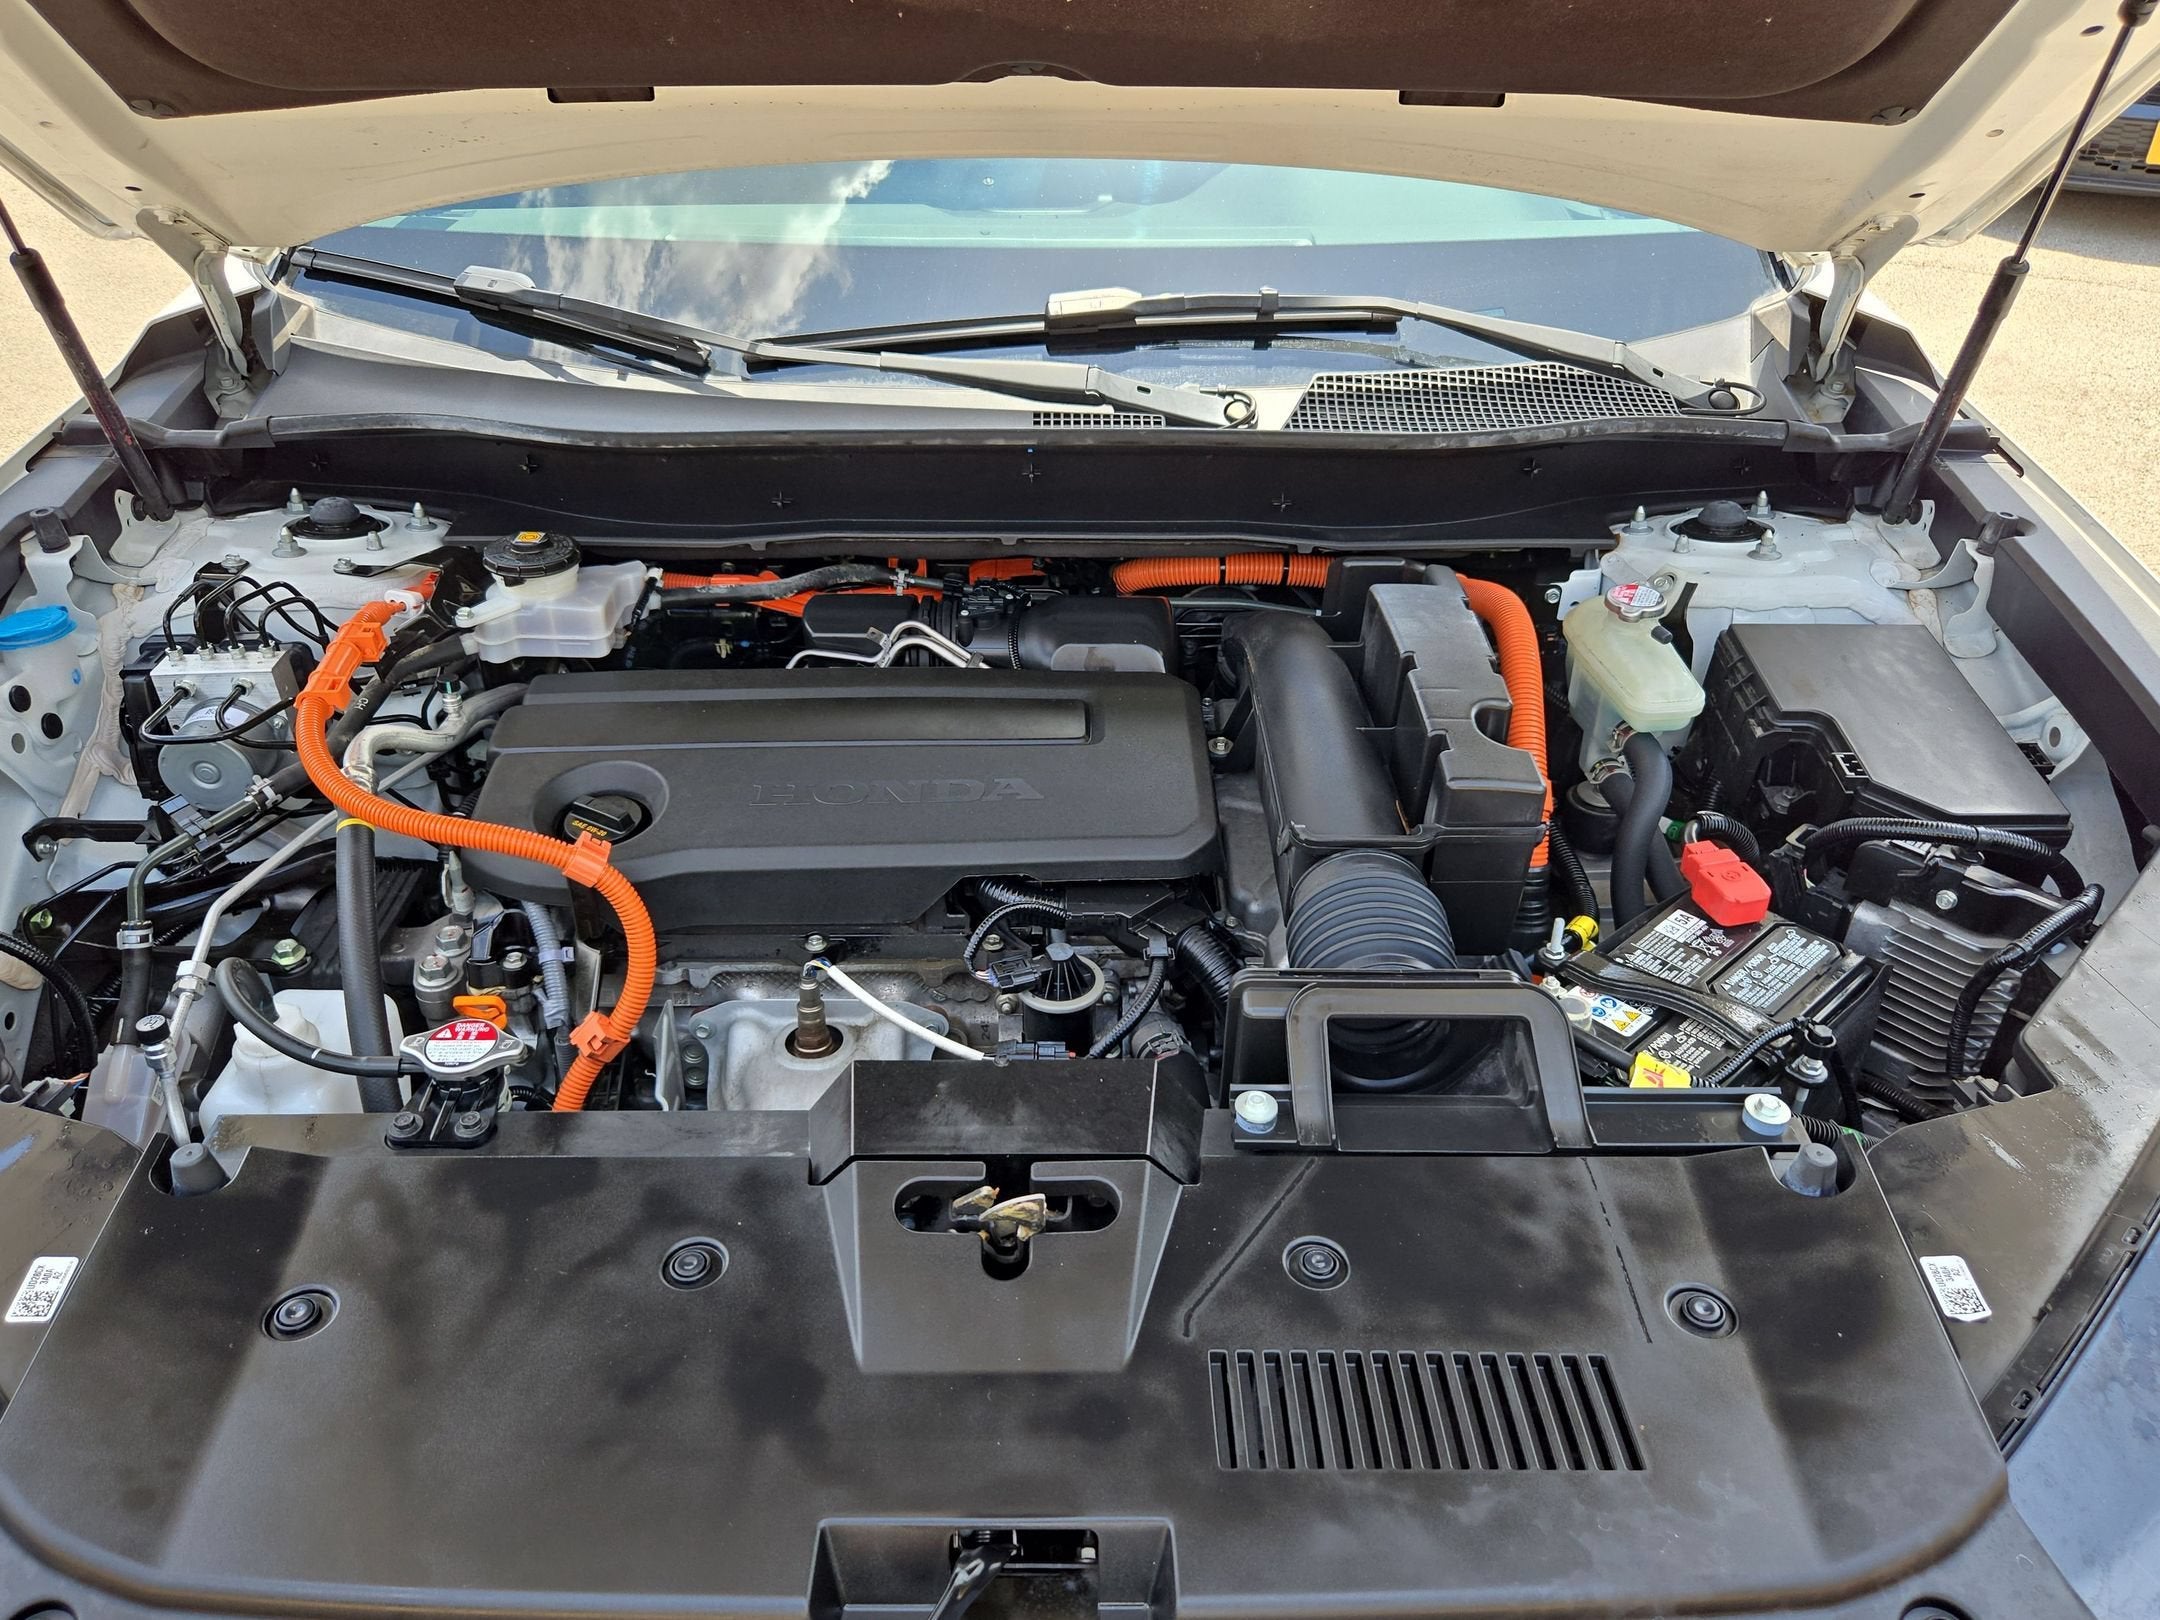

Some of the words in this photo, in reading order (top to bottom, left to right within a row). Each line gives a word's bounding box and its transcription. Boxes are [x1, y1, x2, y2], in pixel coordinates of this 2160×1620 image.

[750, 778, 1045, 805] HONDA
[571, 819, 588, 829] SAE
[586, 825, 608, 837] 0W-20
[1674, 912, 1694, 926] 5A
